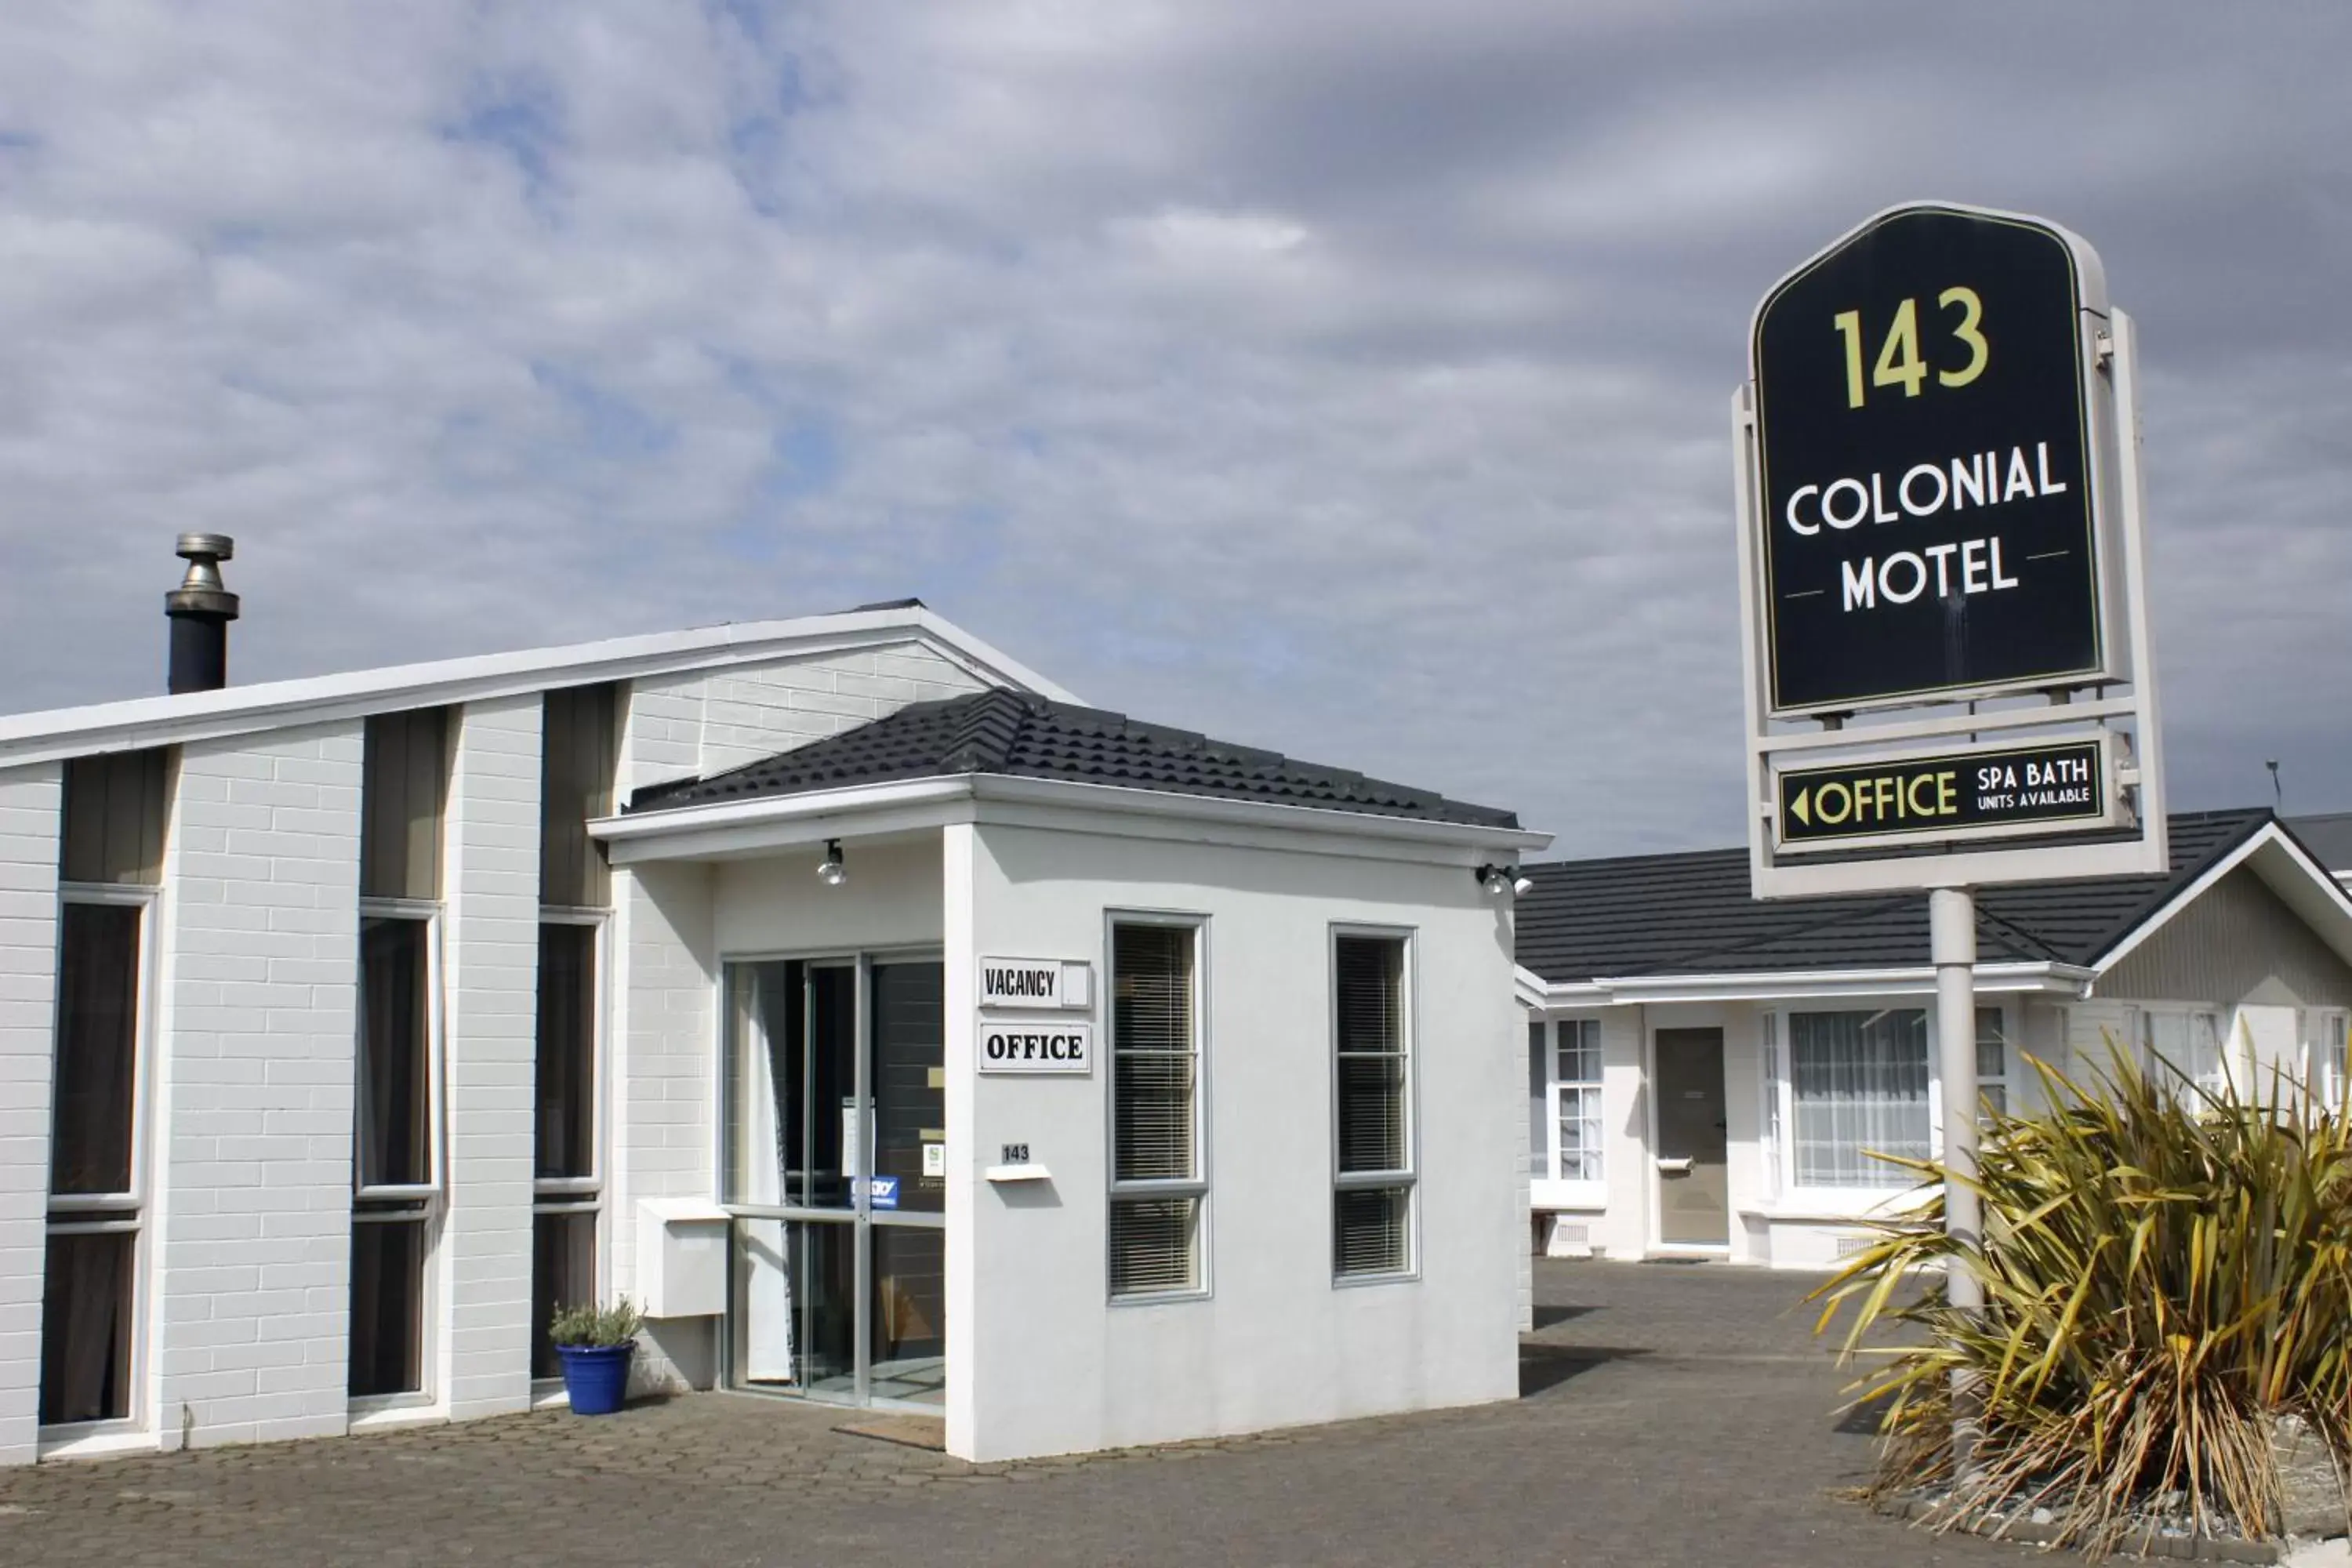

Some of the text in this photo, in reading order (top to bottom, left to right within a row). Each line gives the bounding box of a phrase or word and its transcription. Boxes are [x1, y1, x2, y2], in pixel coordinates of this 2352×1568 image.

[1834, 286, 1989, 408] 143
[1786, 441, 2067, 535] COLONIAL
[1842, 536, 2019, 612] MOTEL
[1814, 758, 2089, 824] OFFICE SPA BATH
[1977, 786, 2090, 811] UNITS AVAILABLE
[985, 968, 1054, 996] VACANCY
[987, 1034, 1083, 1060] OFFICE
[1004, 1145, 1029, 1161] 143
